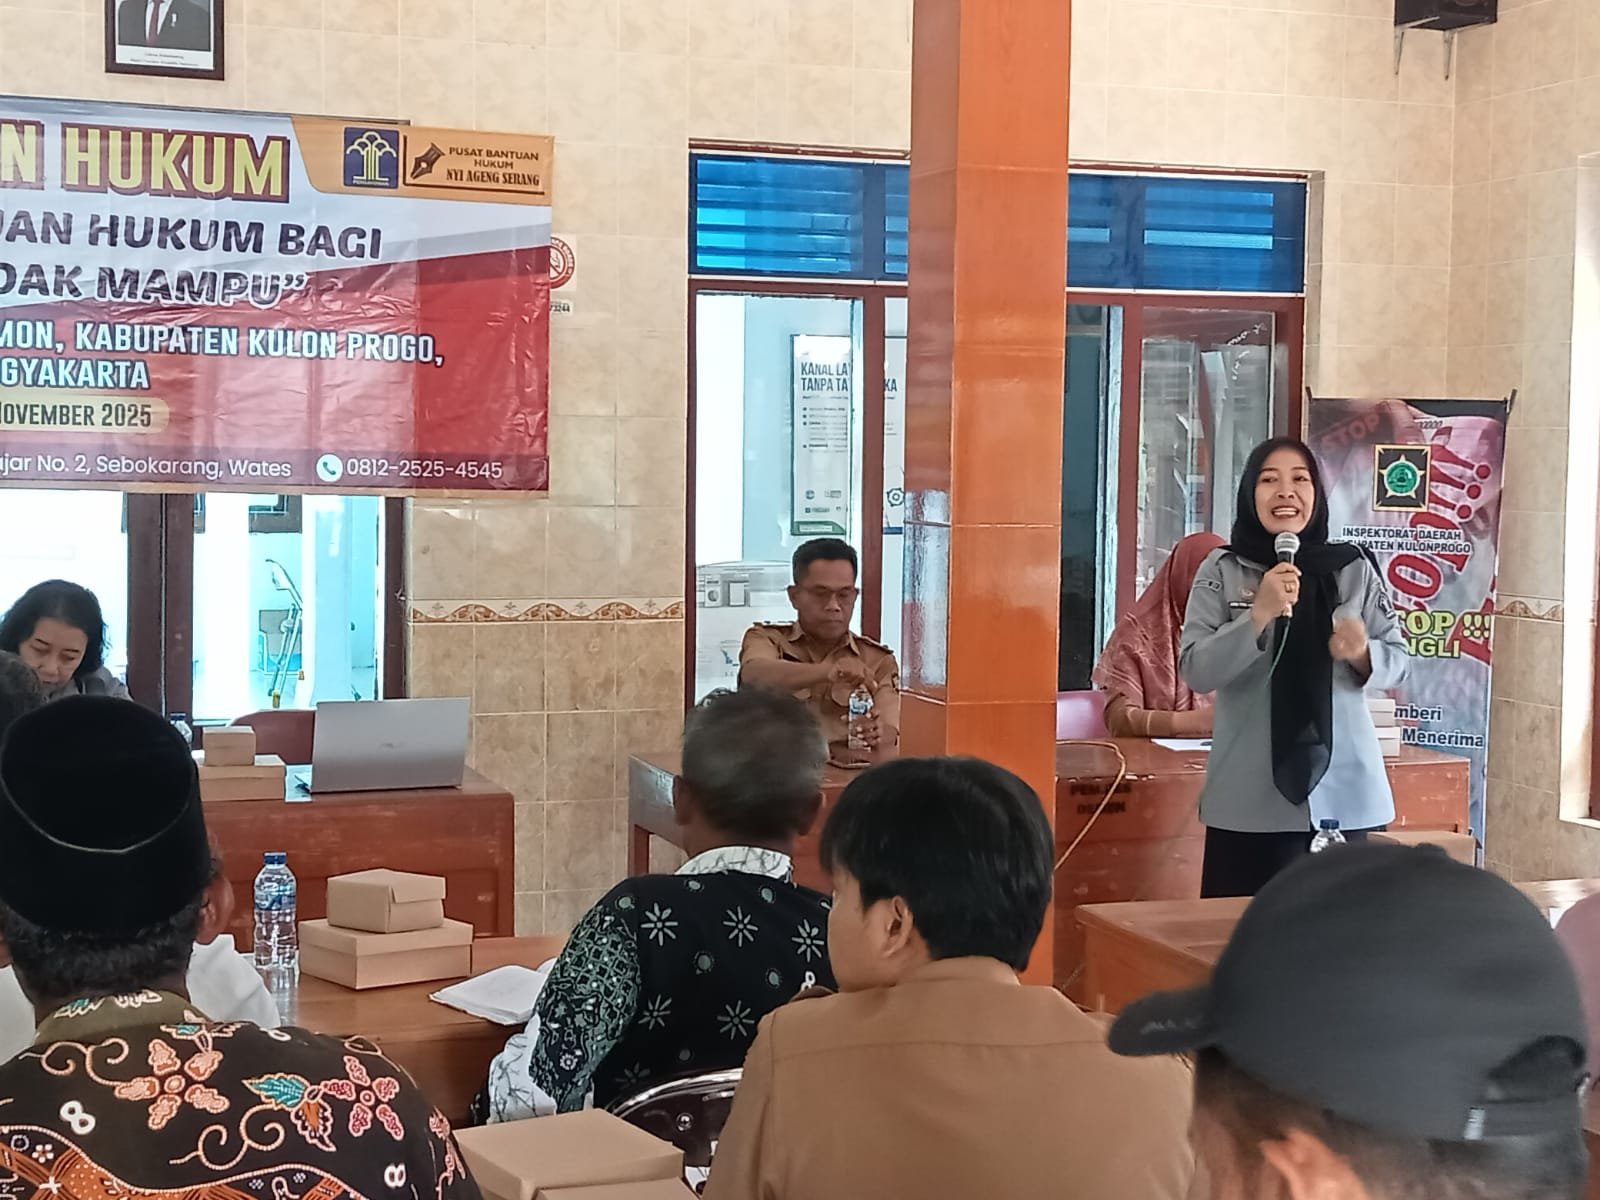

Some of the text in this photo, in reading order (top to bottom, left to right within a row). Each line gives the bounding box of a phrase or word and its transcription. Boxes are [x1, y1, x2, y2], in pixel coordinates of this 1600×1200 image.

[62, 122, 290, 203] HUKUM
[449, 147, 539, 161] PUSAT BANTUAN
[474, 159, 513, 169] HUKUM
[446, 168, 540, 186] NYI AGENG SERANG
[0, 209, 382, 259] AN HUKUM BAGI
[76, 321, 237, 355] KABUPATEN
[248, 328, 336, 359] KULON
[347, 333, 444, 366] PROGO,
[1, 357, 149, 389] GYAKARTA
[801, 362, 833, 376] KANAL
[801, 378, 833, 392] TANPA
[0, 402, 152, 427] OVEMBER 2025
[37, 456, 70, 472] No.
[75, 455, 91, 475] 2,
[96, 456, 223, 478] Sebokarang,
[229, 459, 291, 477] Wates
[346, 458, 503, 478] 0812-2525-4545
[1342, 527, 1461, 540] INSPEKTORAT DAERAH
[1397, 541, 1471, 553] KULONPROGO
[1402, 727, 1484, 748] Menerima
